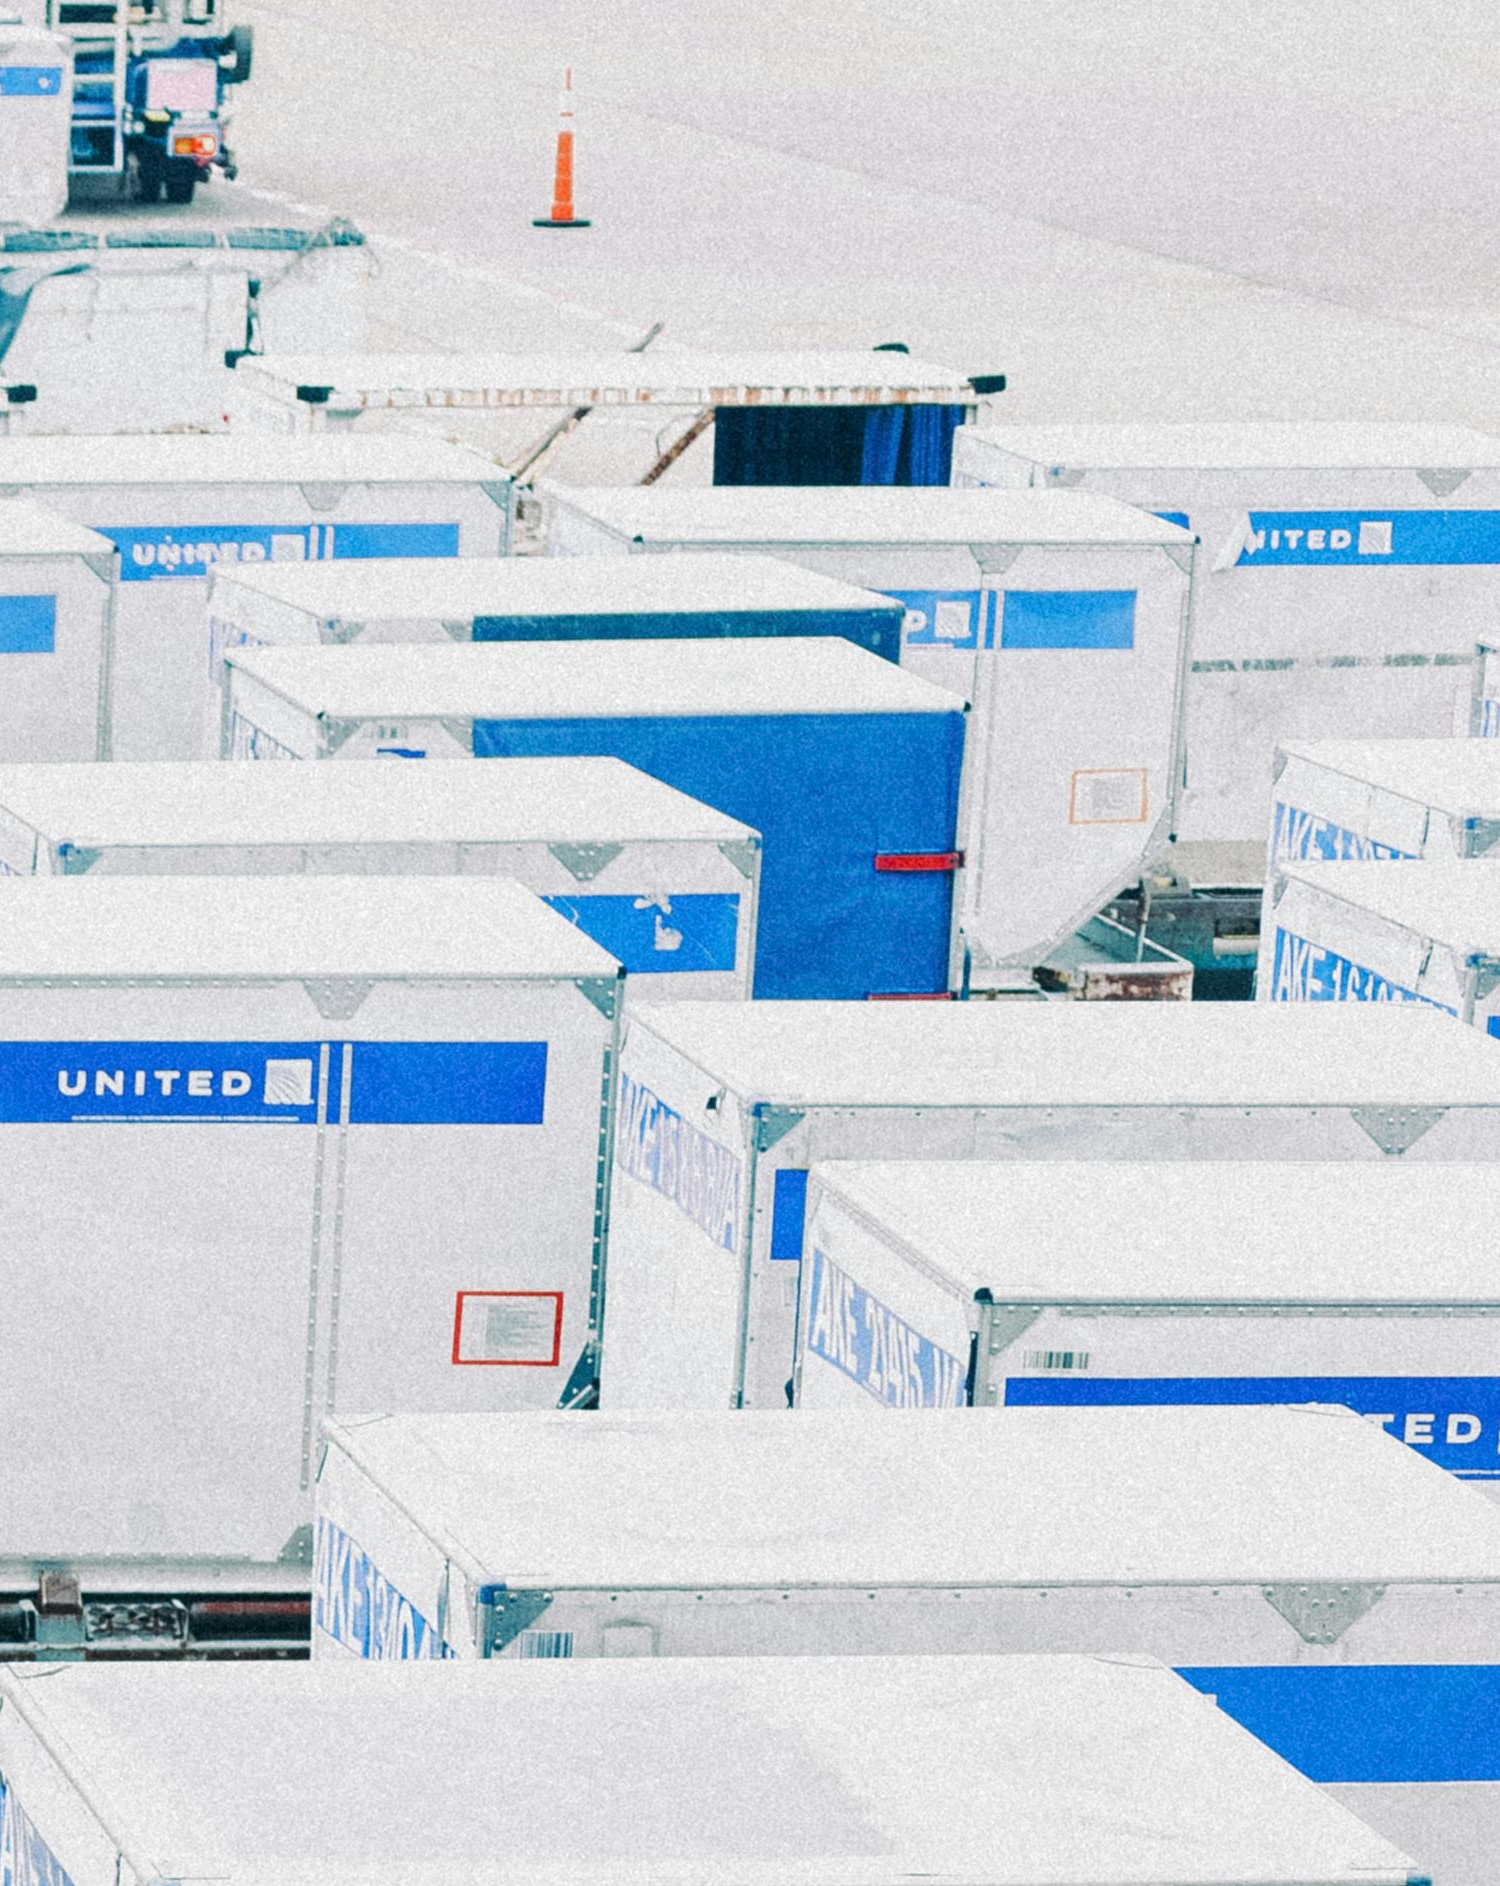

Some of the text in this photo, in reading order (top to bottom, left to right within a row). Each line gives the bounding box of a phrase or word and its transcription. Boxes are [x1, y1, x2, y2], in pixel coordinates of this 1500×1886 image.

[1250, 529, 1352, 549] NITED
[132, 542, 265, 565] UNITED
[57, 1069, 253, 1096] UNITED
[812, 1256, 858, 1374] AKE
